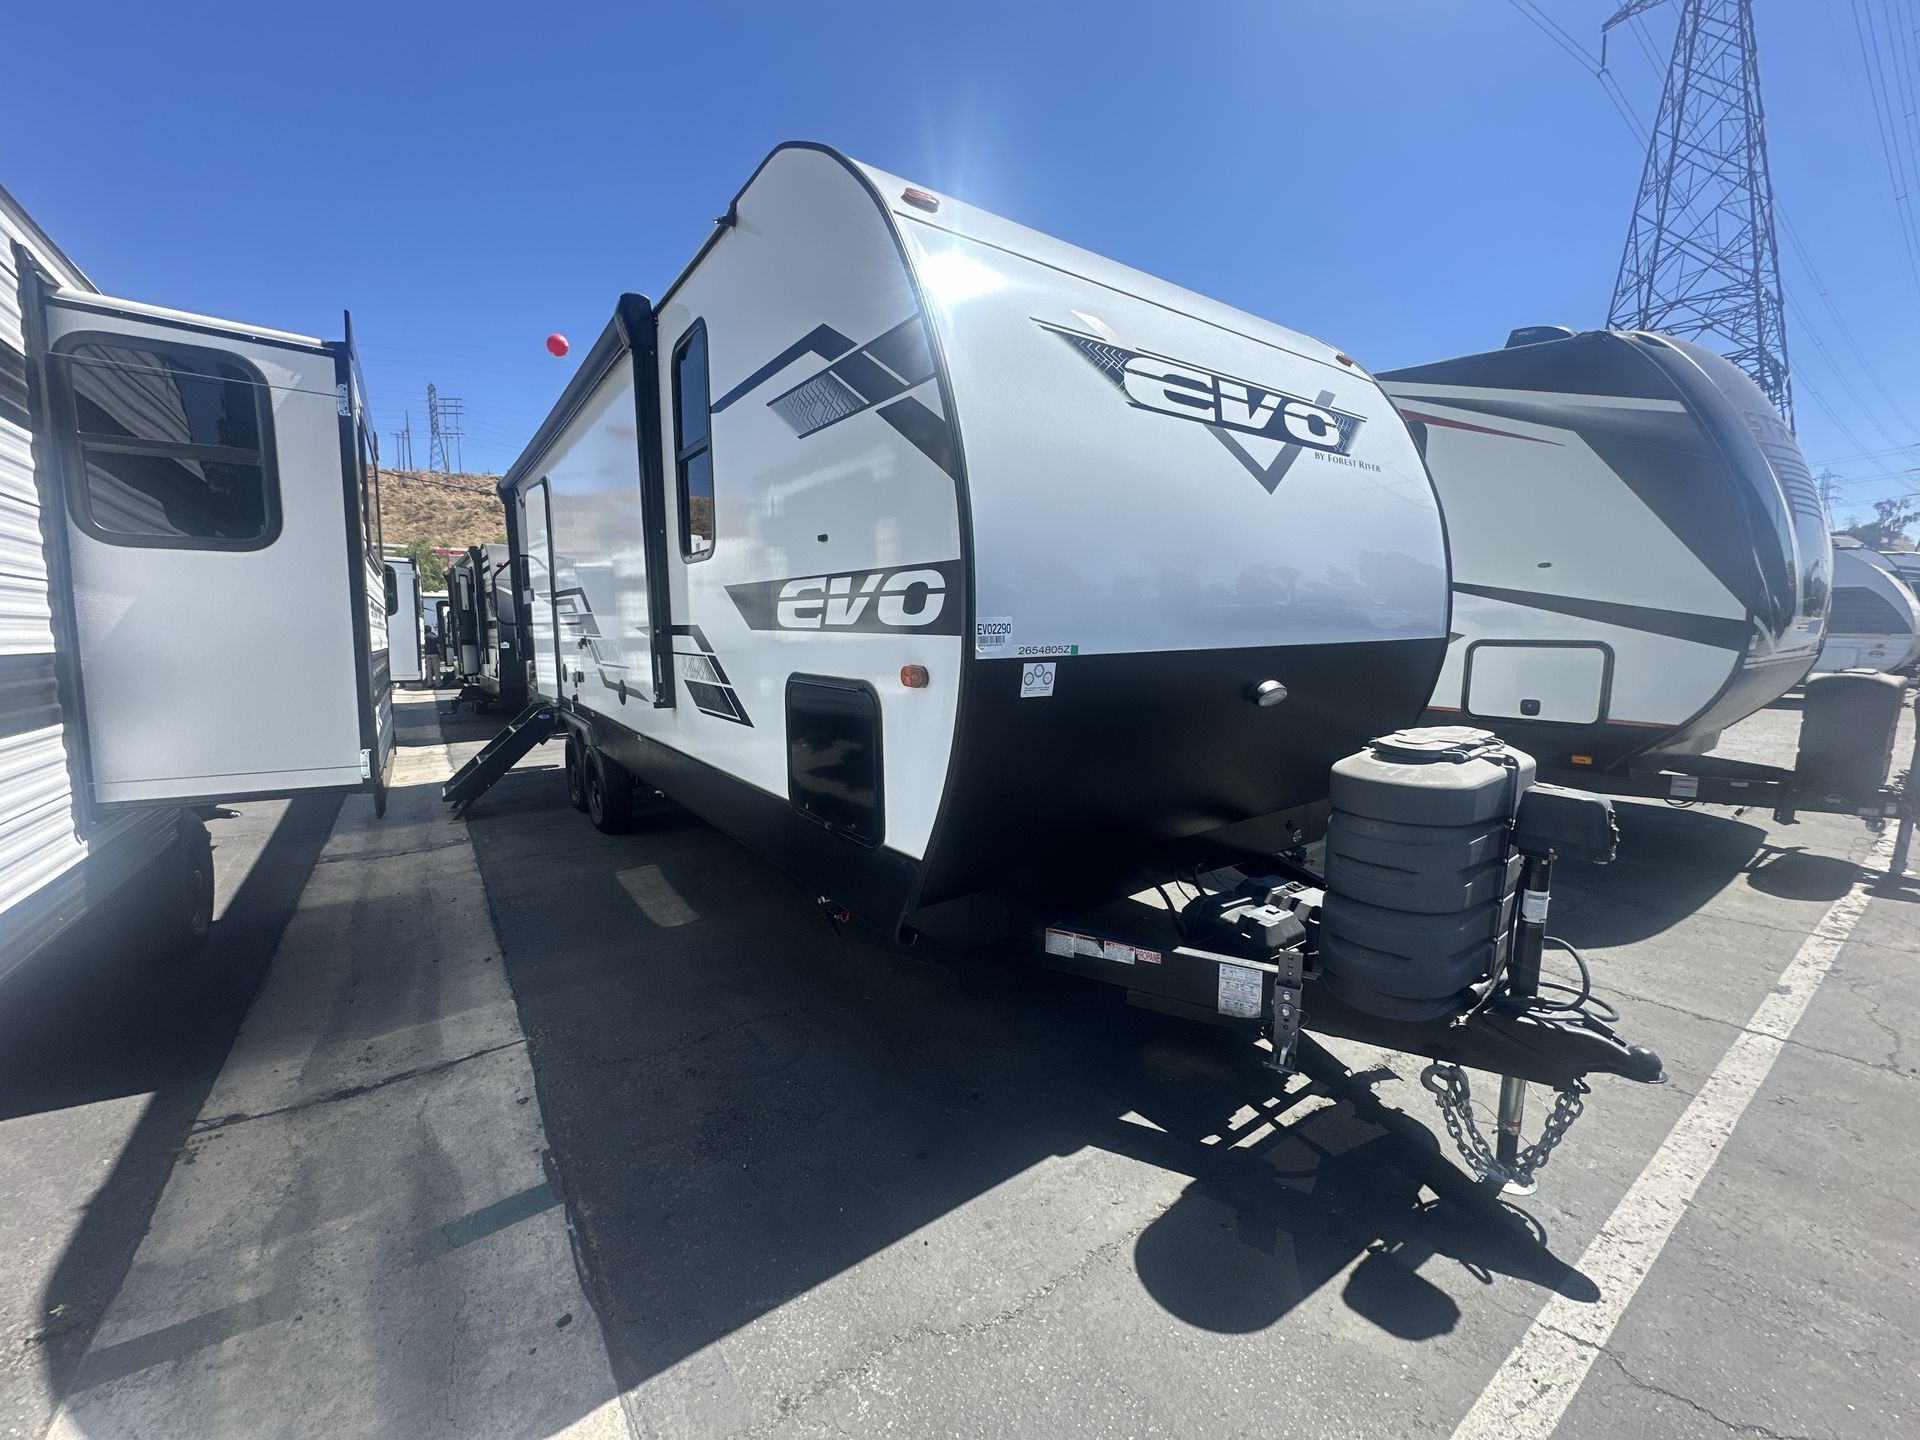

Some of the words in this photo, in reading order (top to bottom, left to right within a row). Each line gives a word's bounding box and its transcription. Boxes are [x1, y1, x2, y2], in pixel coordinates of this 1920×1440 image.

[1123, 356, 1341, 447] EVO
[776, 568, 947, 629] EVO
[1018, 645, 1070, 655] 2654805Z
